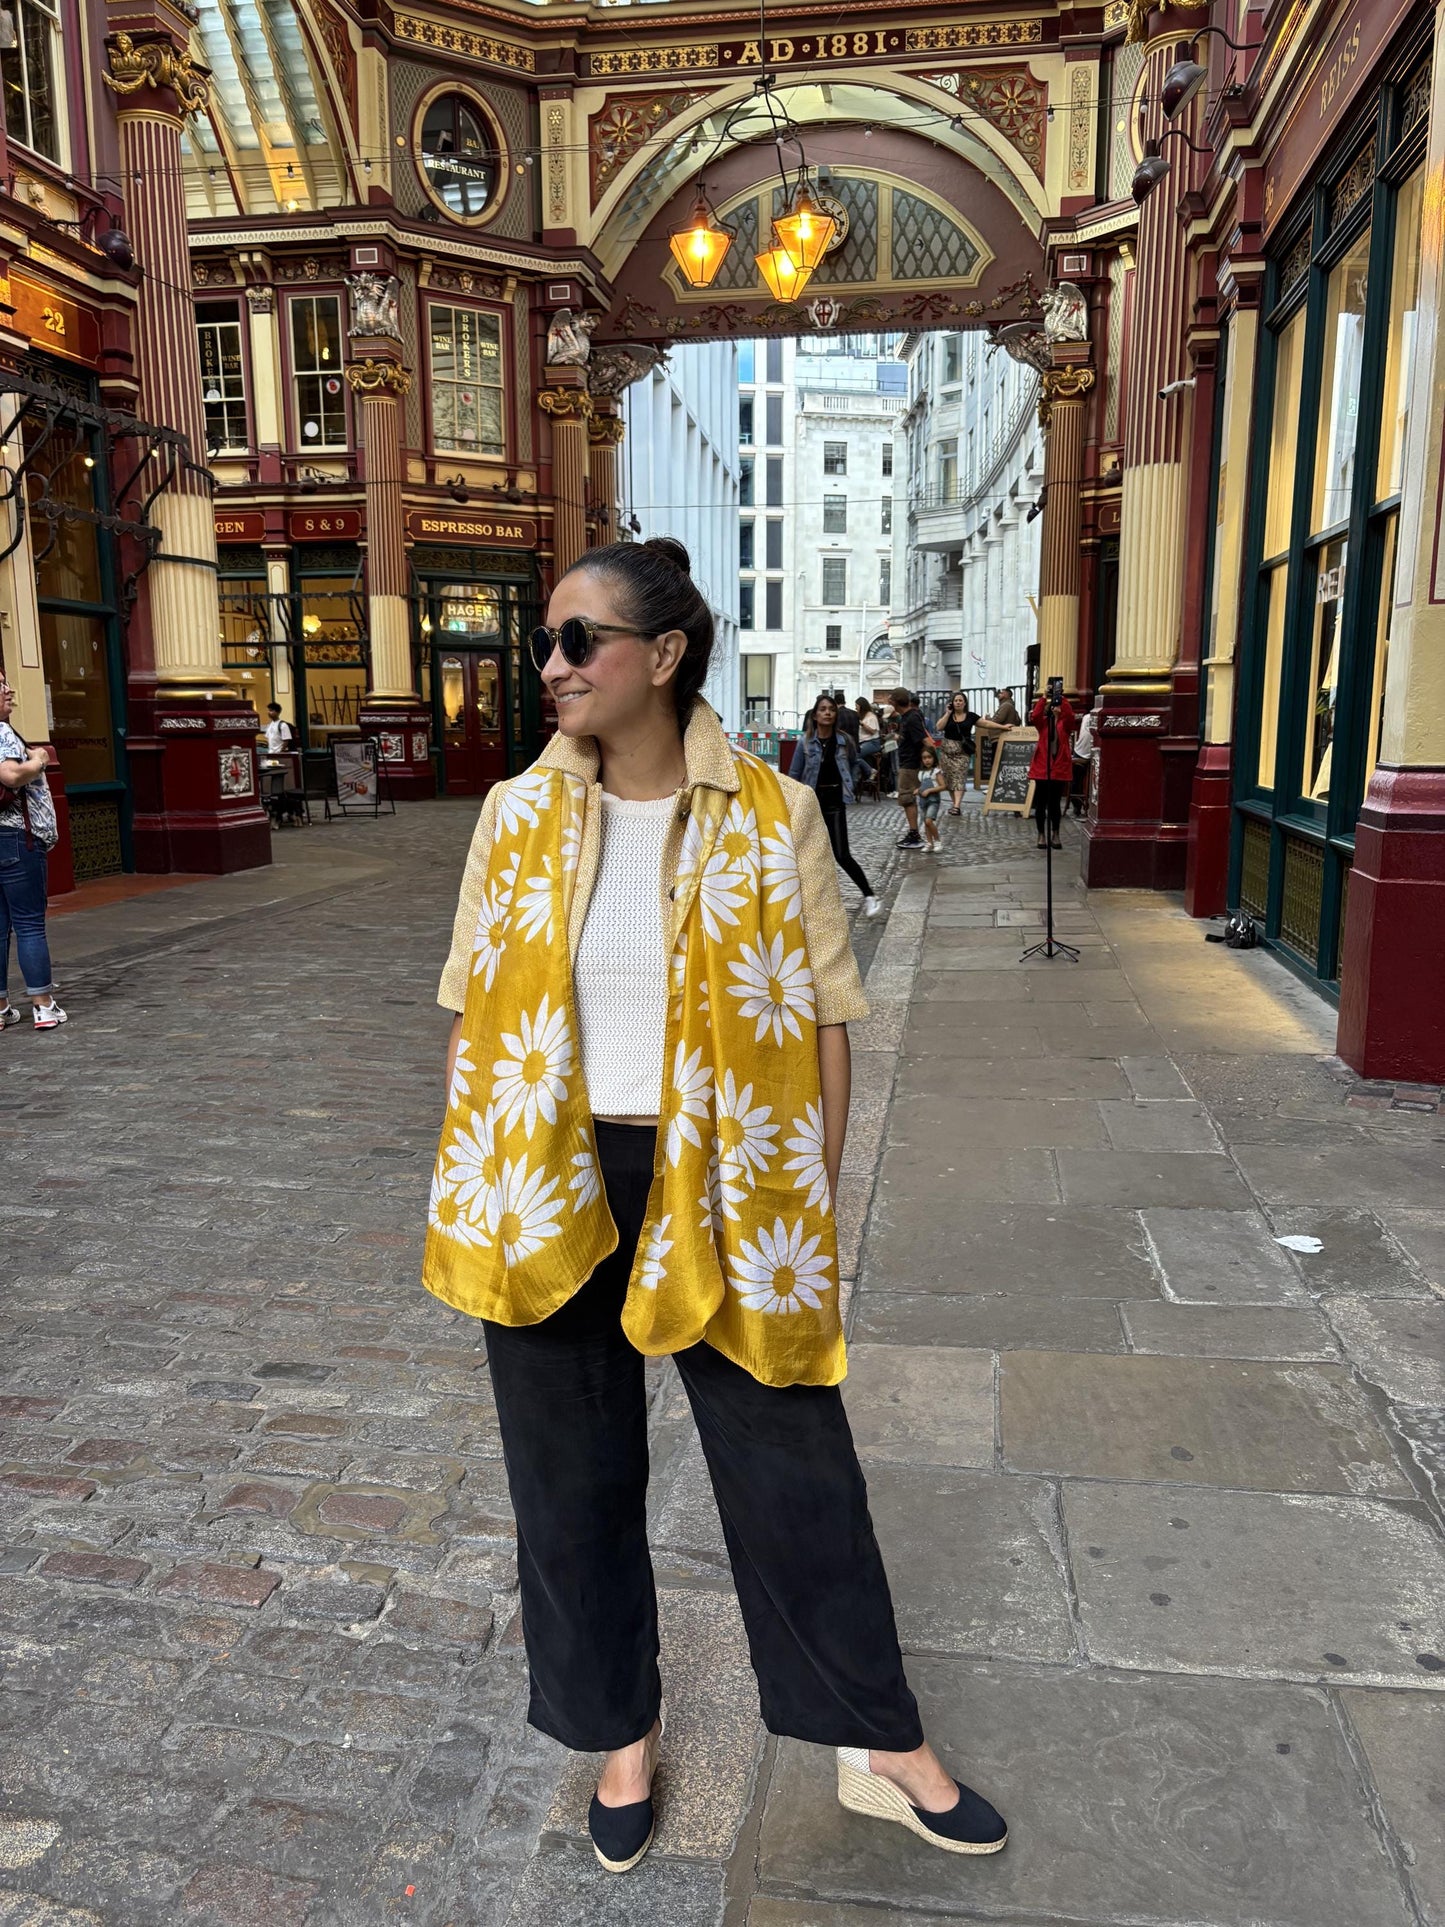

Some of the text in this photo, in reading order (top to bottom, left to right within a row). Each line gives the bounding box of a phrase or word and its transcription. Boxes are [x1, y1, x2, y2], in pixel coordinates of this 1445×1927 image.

[815, 32, 887, 58] 1881
[1319, 20, 1361, 119] REISS
[43, 307, 66, 335] 22
[435, 342, 450, 351] BAR
[461, 314, 471, 377] BROKERS
[482, 349, 497, 357] BAR
[224, 362, 238, 370] BAR
[305, 518, 345, 531] 8 & 9
[421, 519, 523, 539] ESPRESSO BAR
[447, 603, 492, 617] HAGEN
